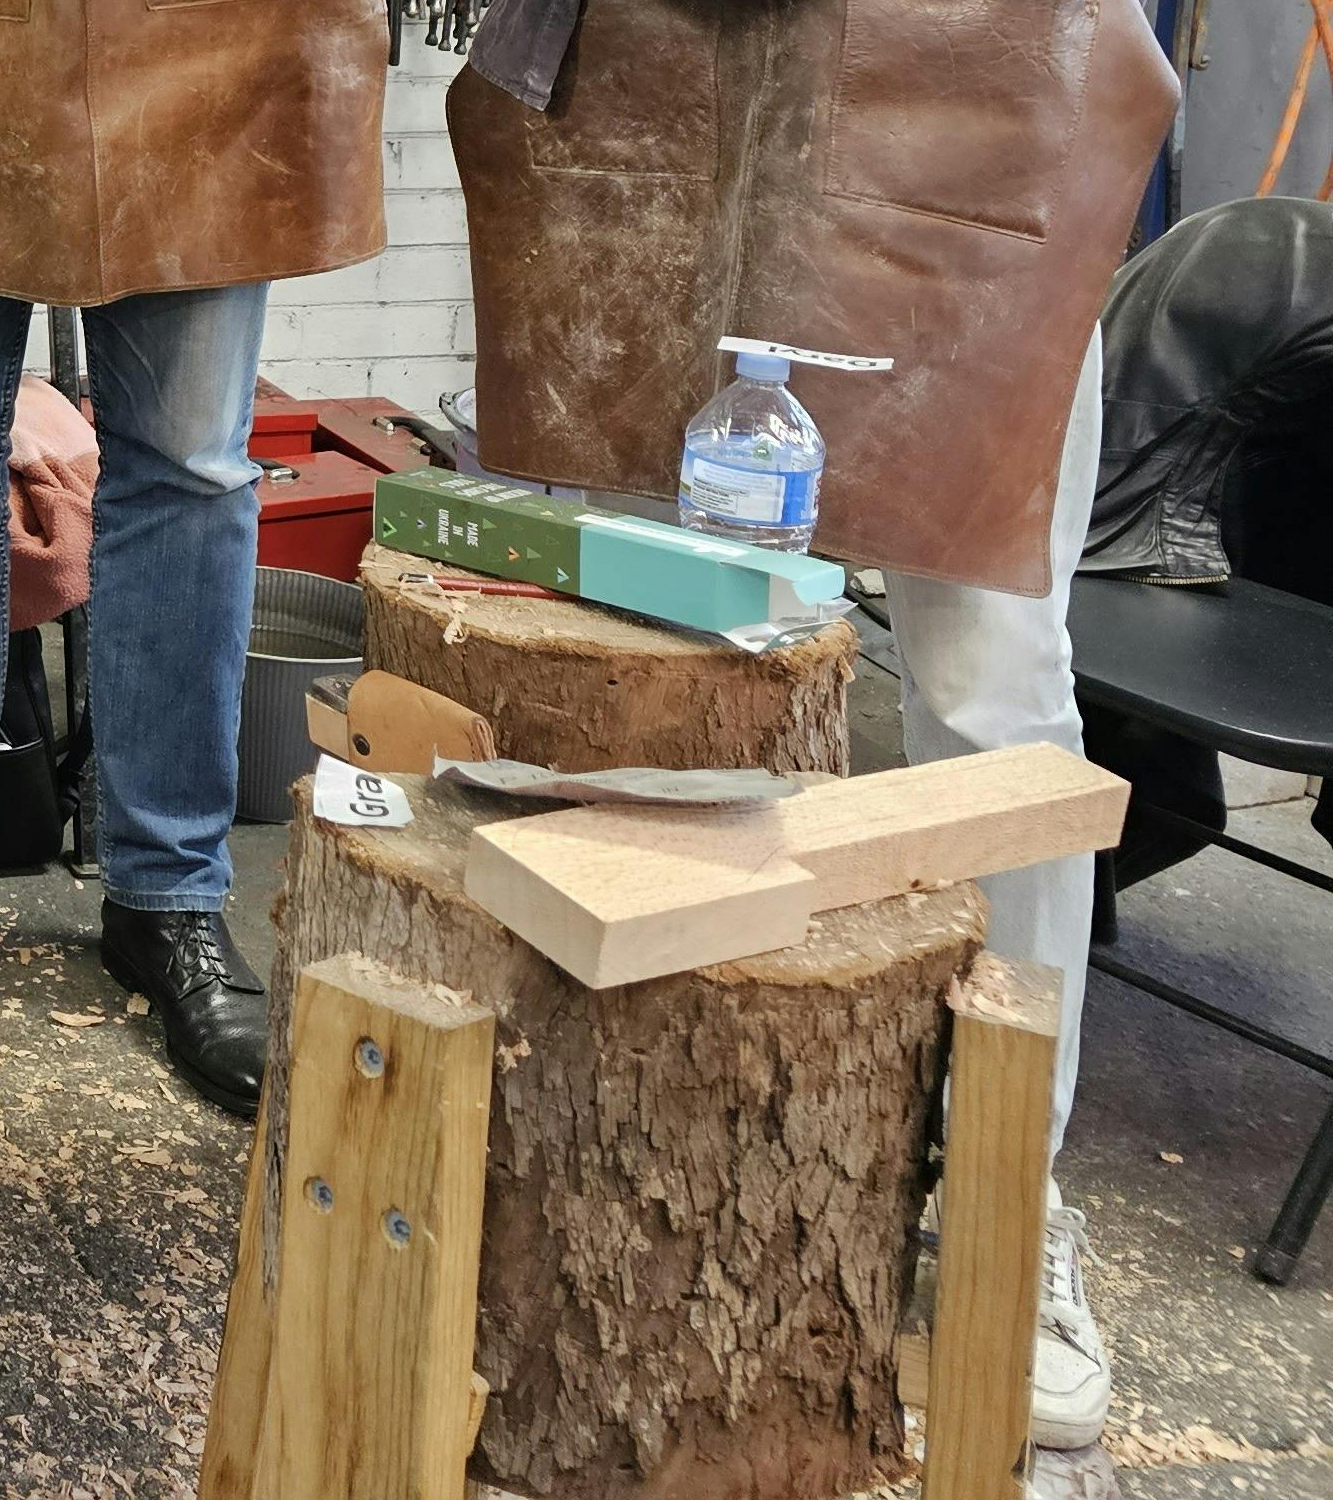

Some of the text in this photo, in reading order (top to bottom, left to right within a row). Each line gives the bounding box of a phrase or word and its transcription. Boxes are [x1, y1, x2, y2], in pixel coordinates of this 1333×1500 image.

[437, 508, 450, 546] UKRAINE
[452, 524, 464, 537] IN
[466, 521, 479, 548] MADE
[349, 773, 390, 817] Gra
